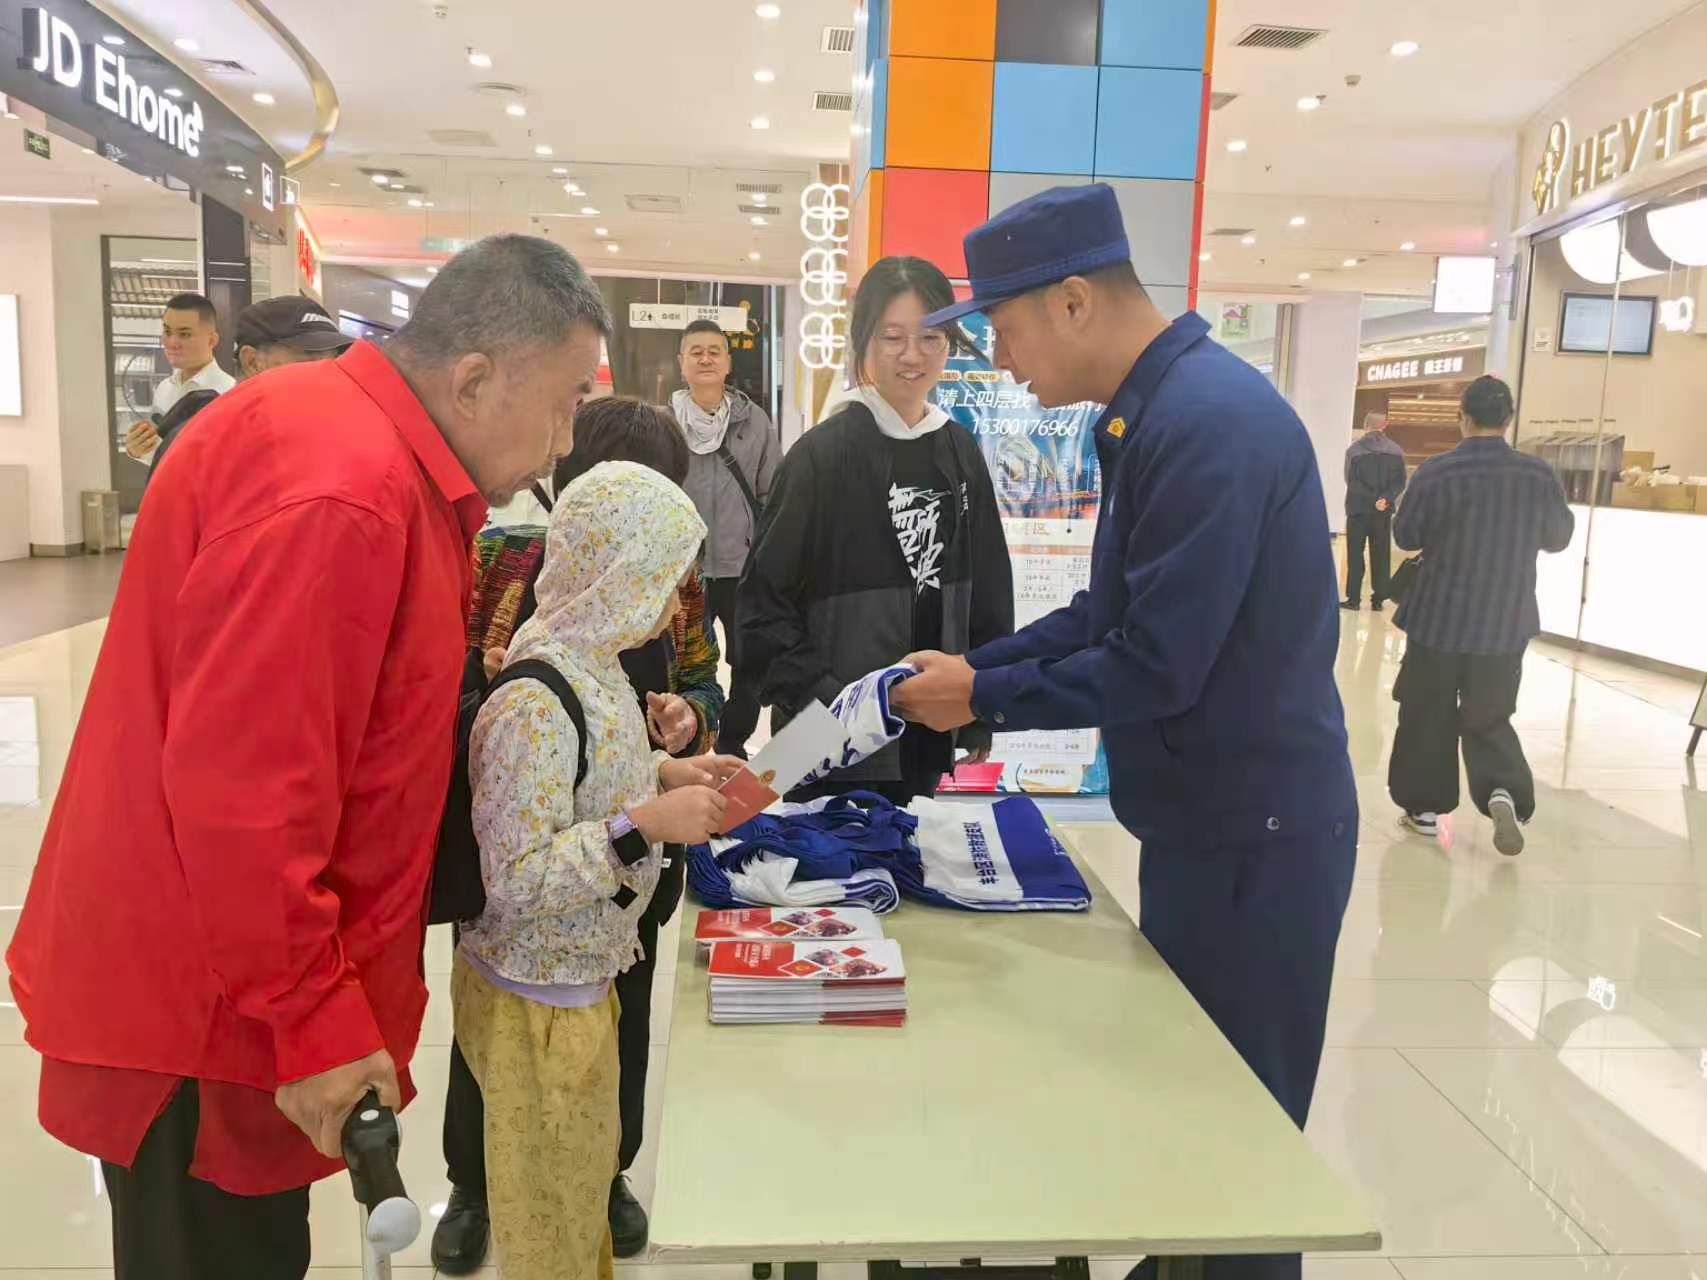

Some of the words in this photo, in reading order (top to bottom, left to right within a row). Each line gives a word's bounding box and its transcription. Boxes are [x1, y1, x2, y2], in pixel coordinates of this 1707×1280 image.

[32, 7, 82, 88] JD
[94, 43, 204, 158] Ehome
[1367, 360, 1419, 382] CHAGEE
[971, 417, 1079, 437] 15300176966
